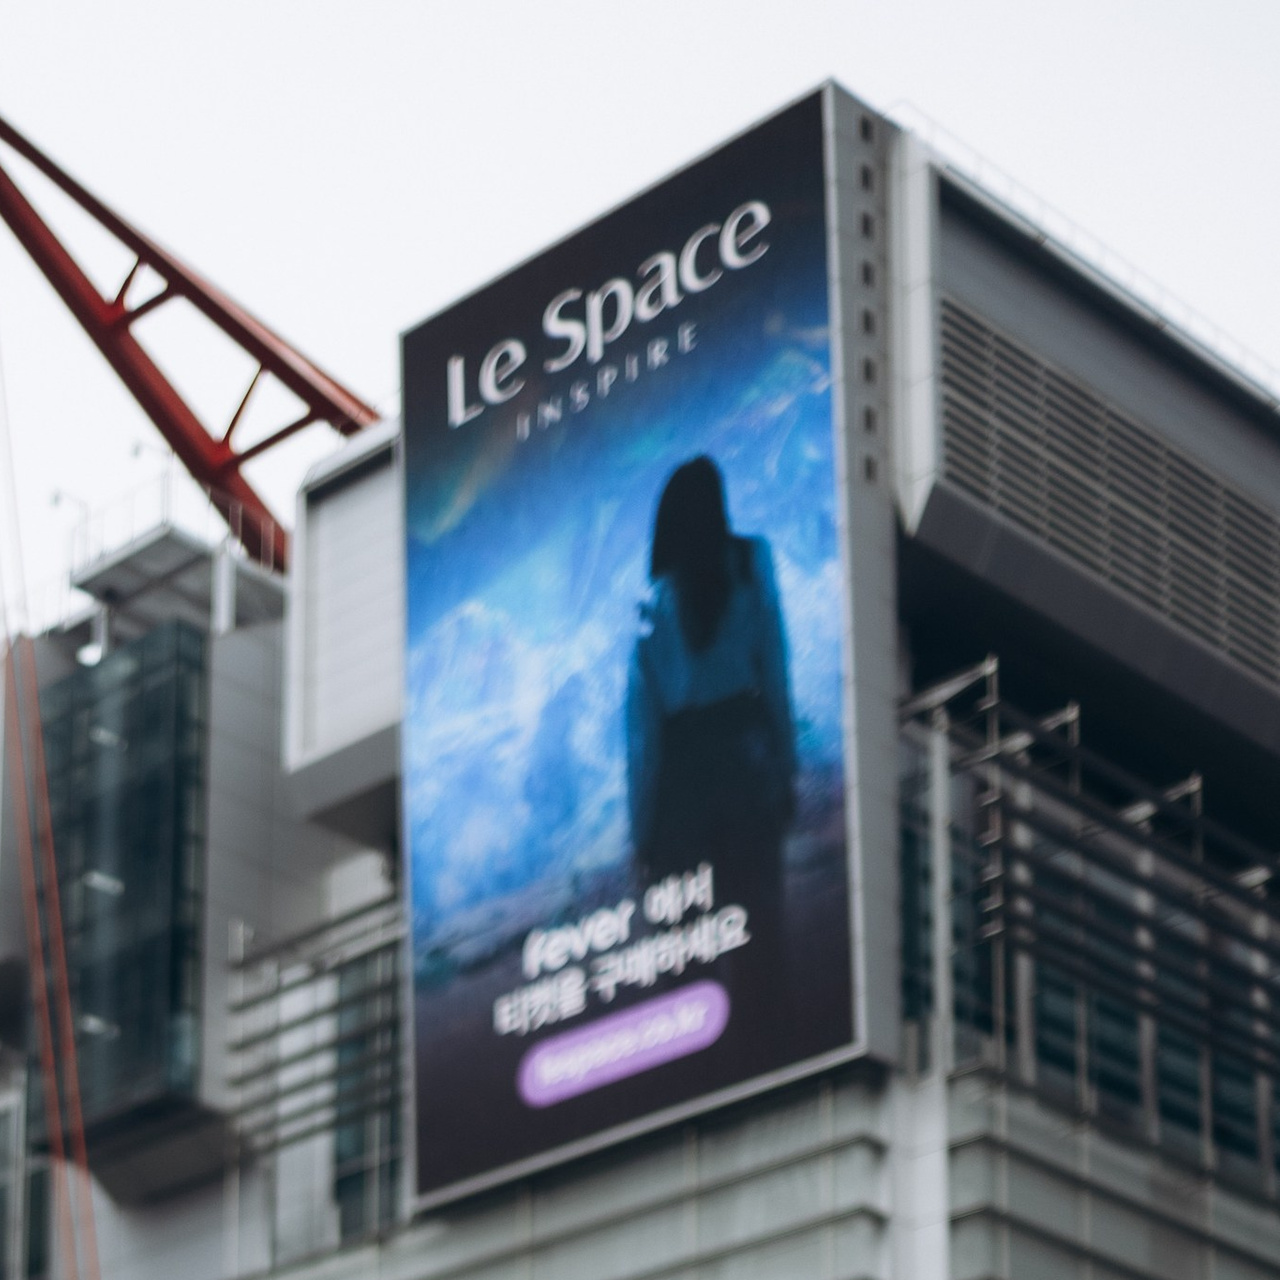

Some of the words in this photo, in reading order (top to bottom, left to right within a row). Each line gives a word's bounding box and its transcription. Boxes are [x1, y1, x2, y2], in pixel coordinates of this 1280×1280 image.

[446, 337, 528, 430] Le
[542, 199, 772, 375] Space
[515, 321, 701, 441] INSPIRE
